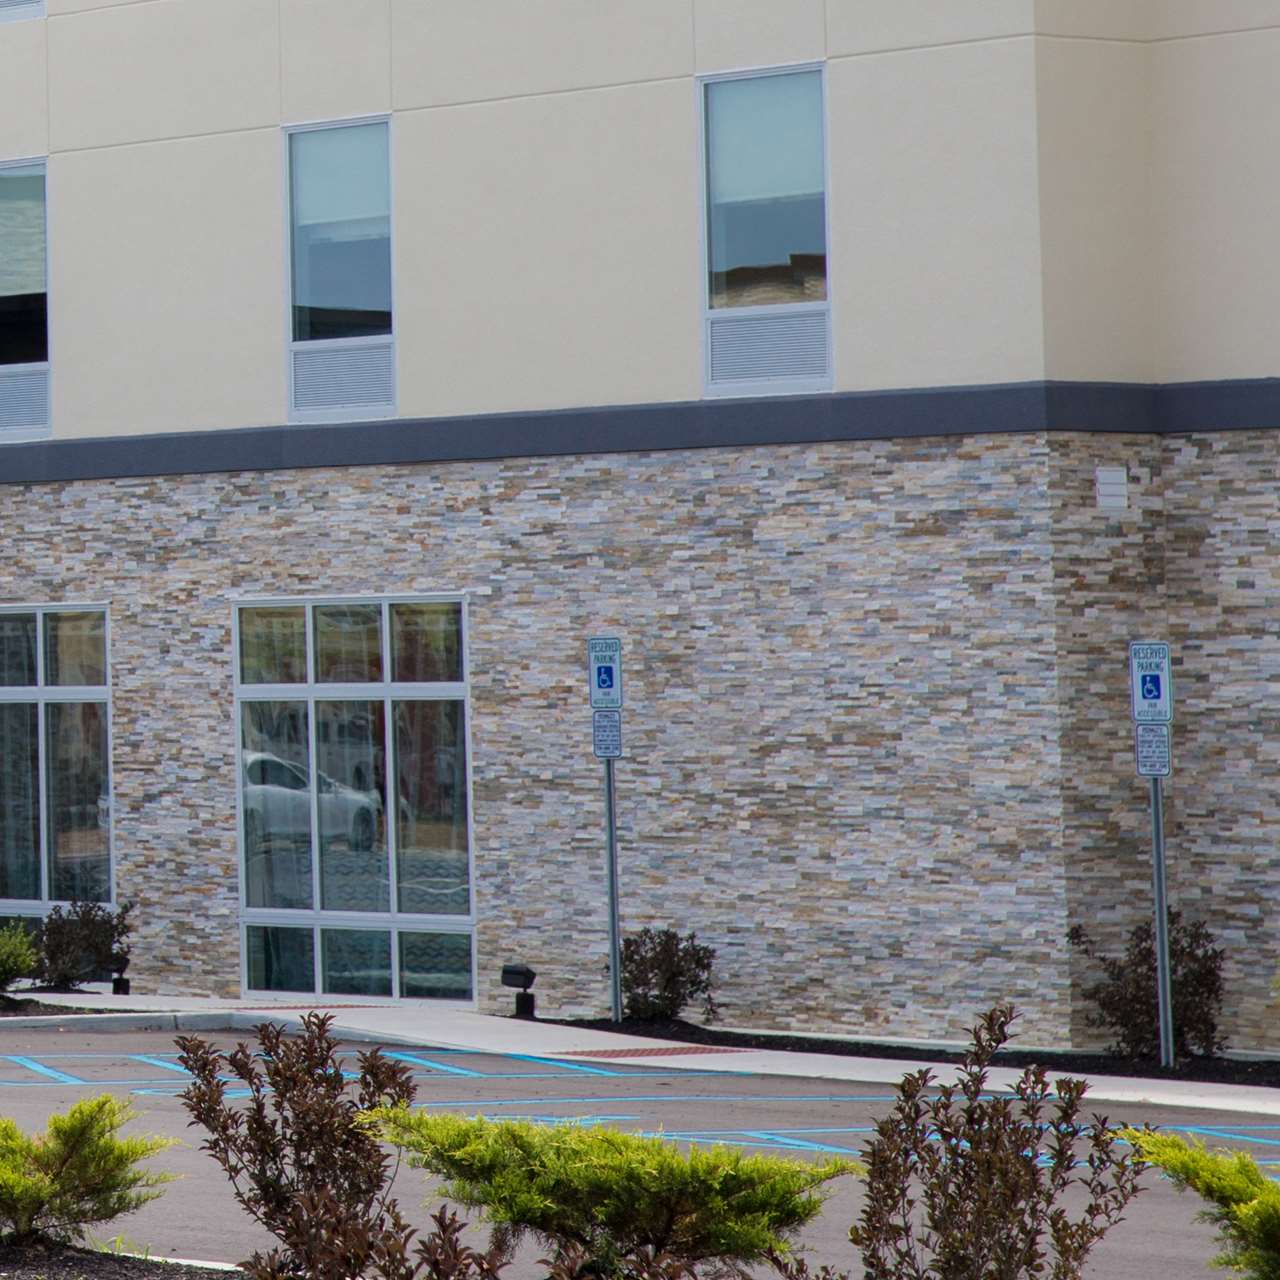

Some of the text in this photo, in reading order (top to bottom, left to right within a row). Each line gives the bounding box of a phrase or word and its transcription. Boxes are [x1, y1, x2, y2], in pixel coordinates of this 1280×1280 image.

[591, 642, 619, 653] RESERVED
[1133, 647, 1167, 660] RESERVED
[1137, 661, 1164, 673] PARKING
